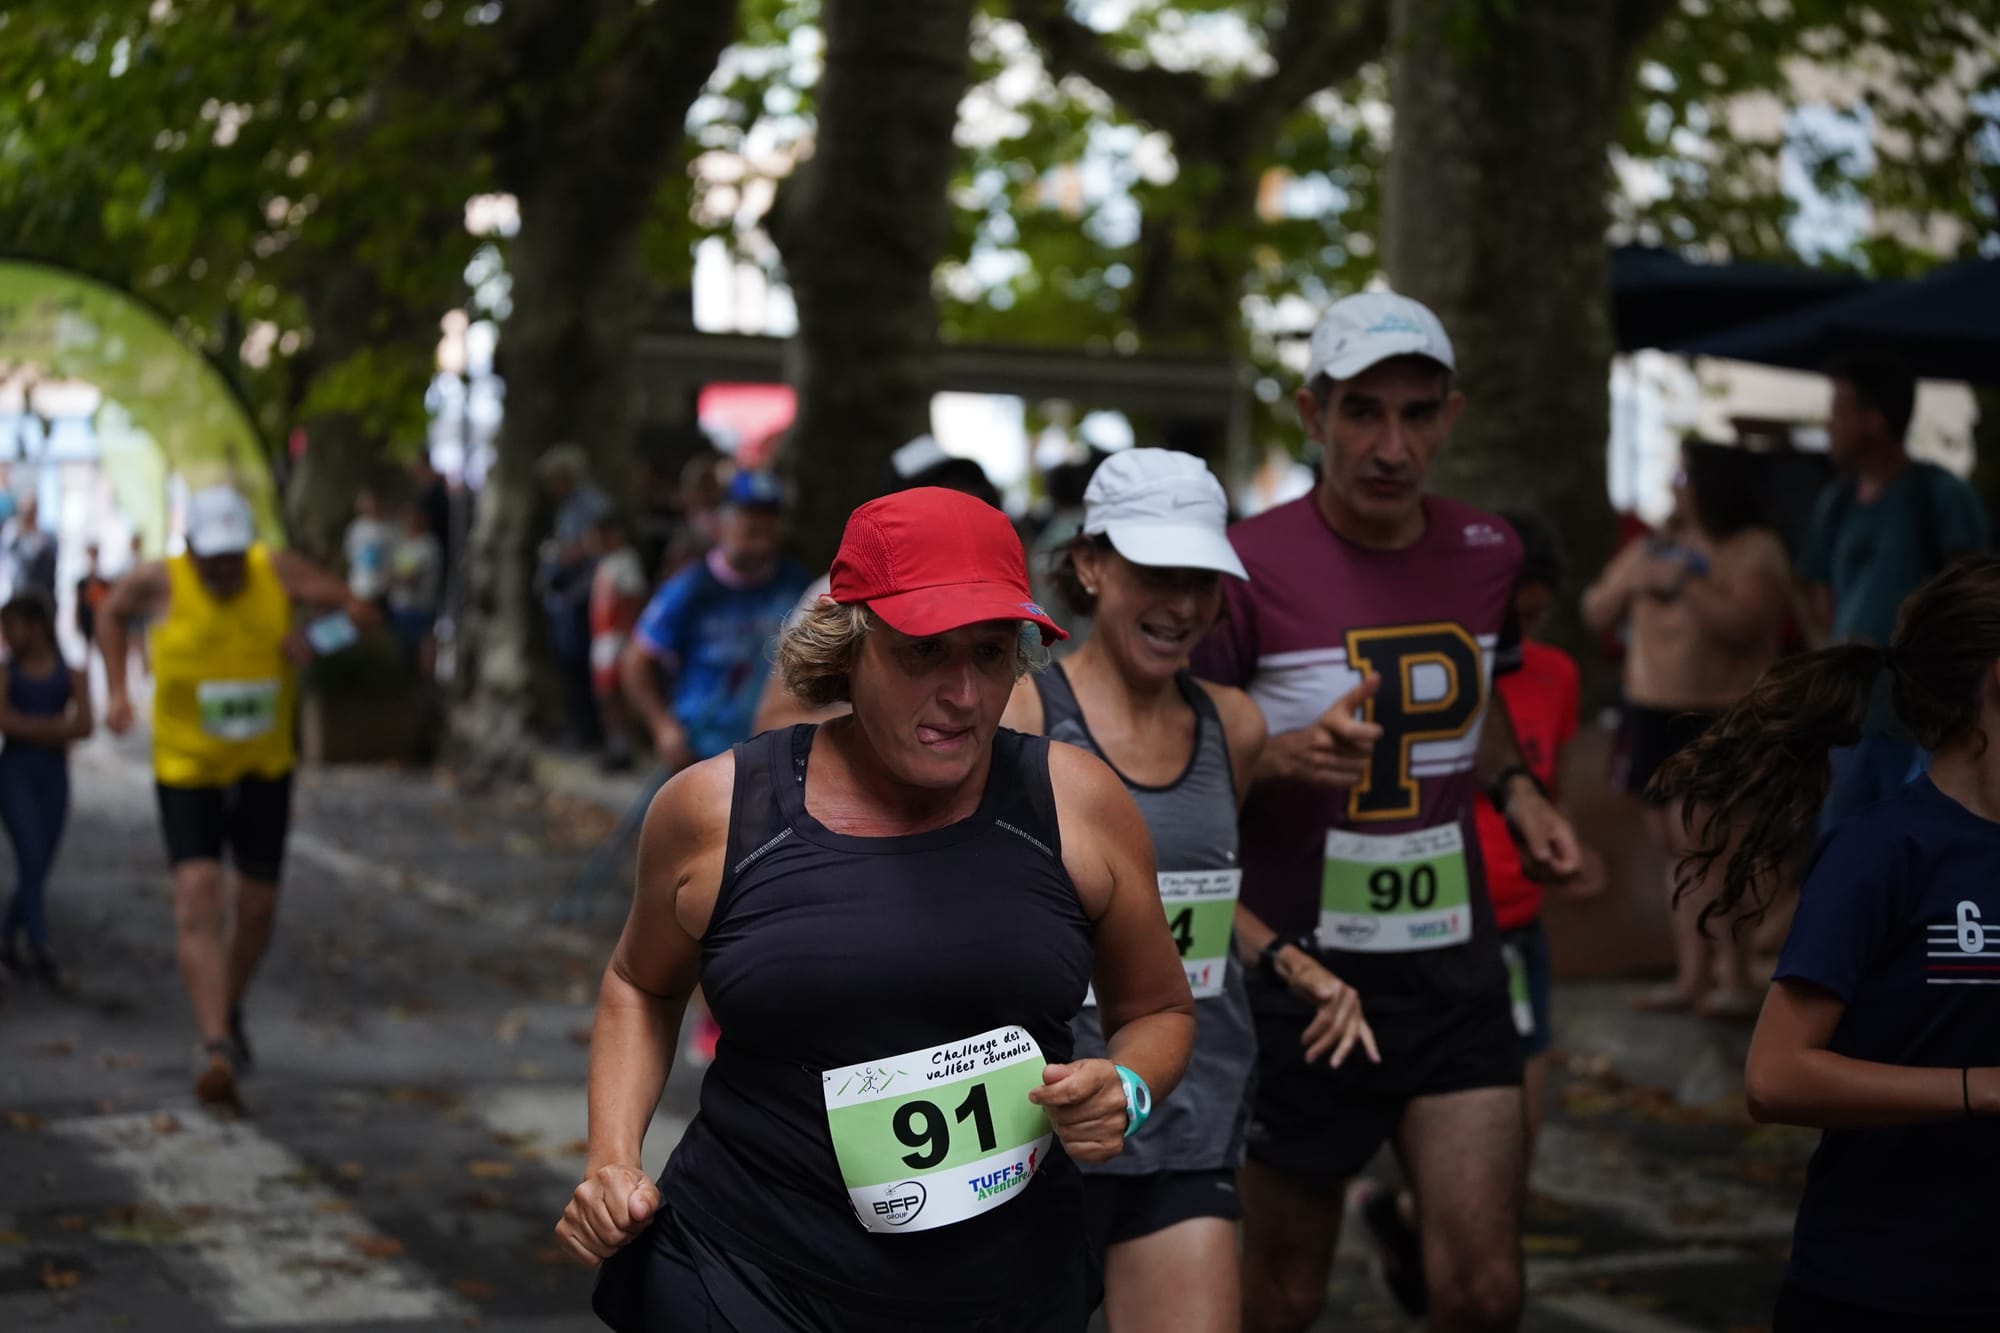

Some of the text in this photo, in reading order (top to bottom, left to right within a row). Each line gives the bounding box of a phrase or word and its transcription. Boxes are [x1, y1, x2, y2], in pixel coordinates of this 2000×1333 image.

[1344, 621, 1486, 822] P
[1368, 864, 1437, 913] 90
[1956, 900, 1985, 953] 6
[926, 1042, 1031, 1080] vallées cévenoles
[932, 1031, 1020, 1064] Challenge des
[892, 1083, 997, 1170] 91
[968, 1162, 1024, 1193] TUFF'S
[978, 1171, 1028, 1201] Aventure
[872, 1195, 919, 1215] BFP
[886, 1212, 908, 1220] GROUP
